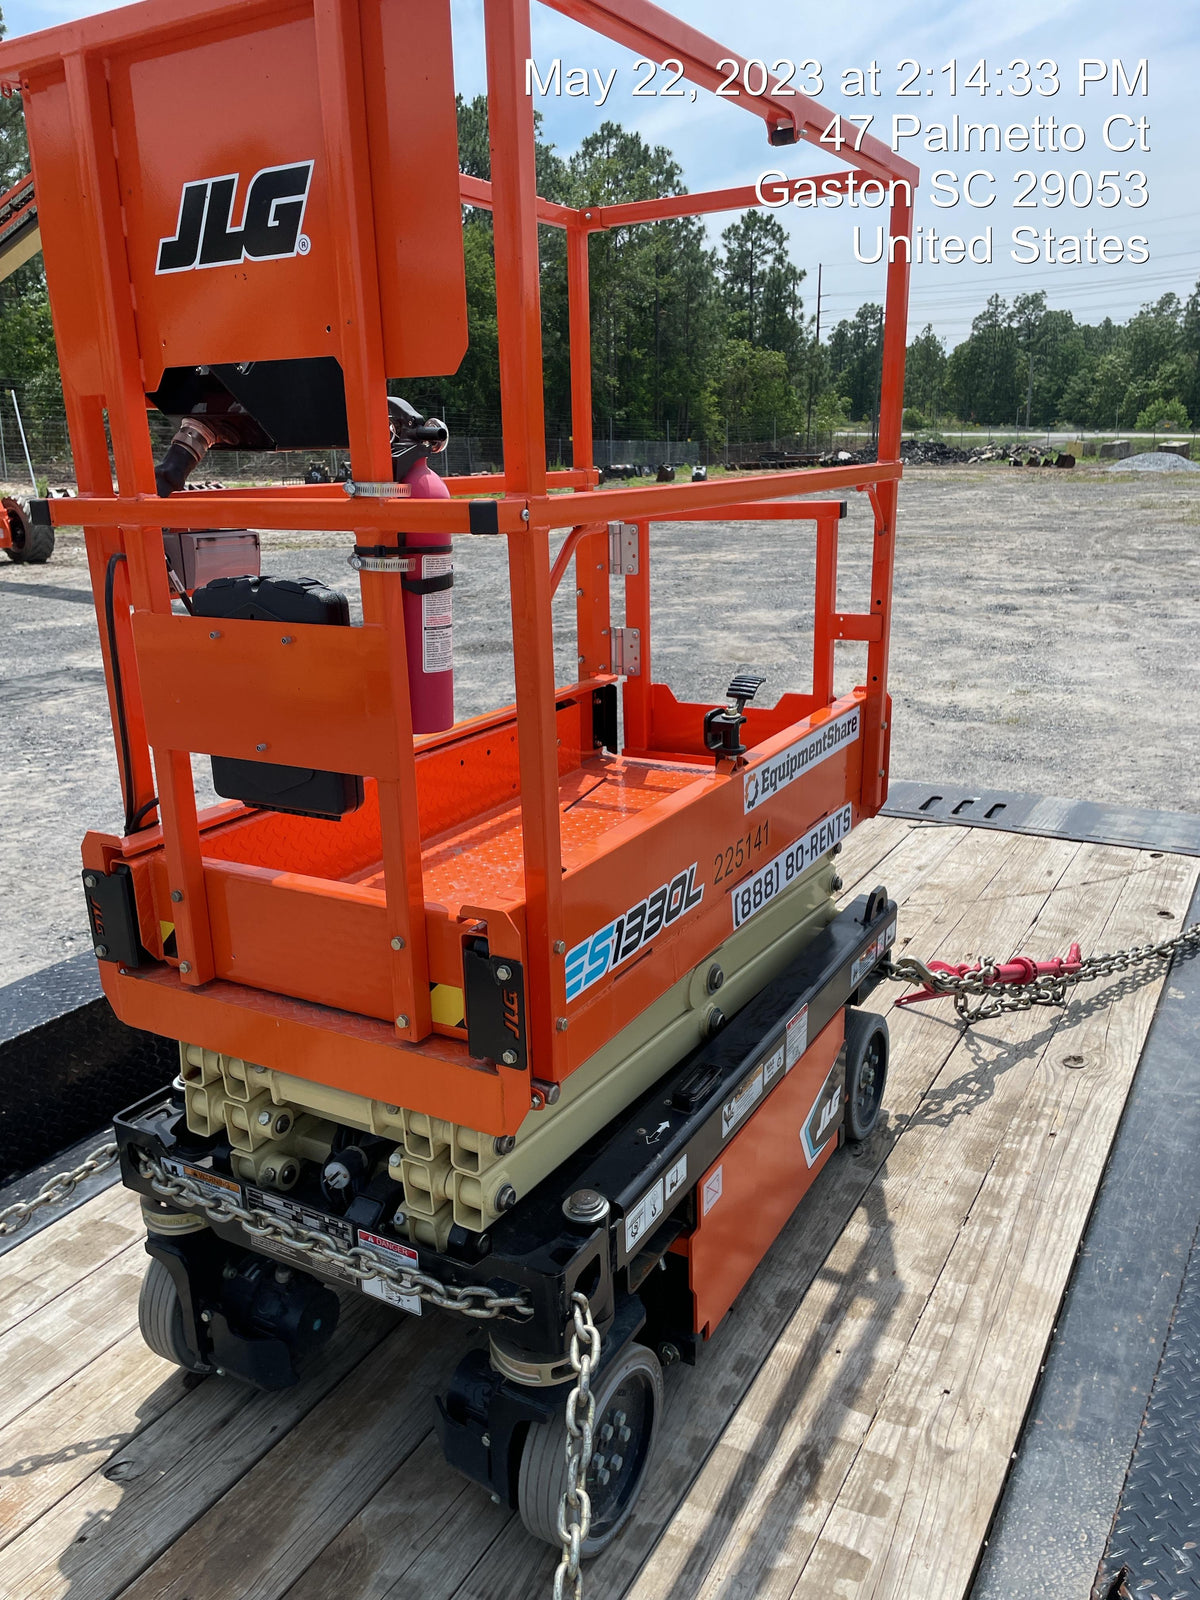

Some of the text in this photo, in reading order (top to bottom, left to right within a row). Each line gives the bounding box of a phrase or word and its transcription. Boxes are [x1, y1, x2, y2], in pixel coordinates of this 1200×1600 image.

[760, 714, 858, 795] EquipmentShare
[713, 820, 770, 886] 225141
[733, 805, 851, 928] (888) 80-RENTS
[565, 862, 704, 1003] ES1330L
[502, 988, 520, 1040] JLG
[815, 1084, 842, 1141] JLG
[376, 1238, 409, 1256] DANGER
